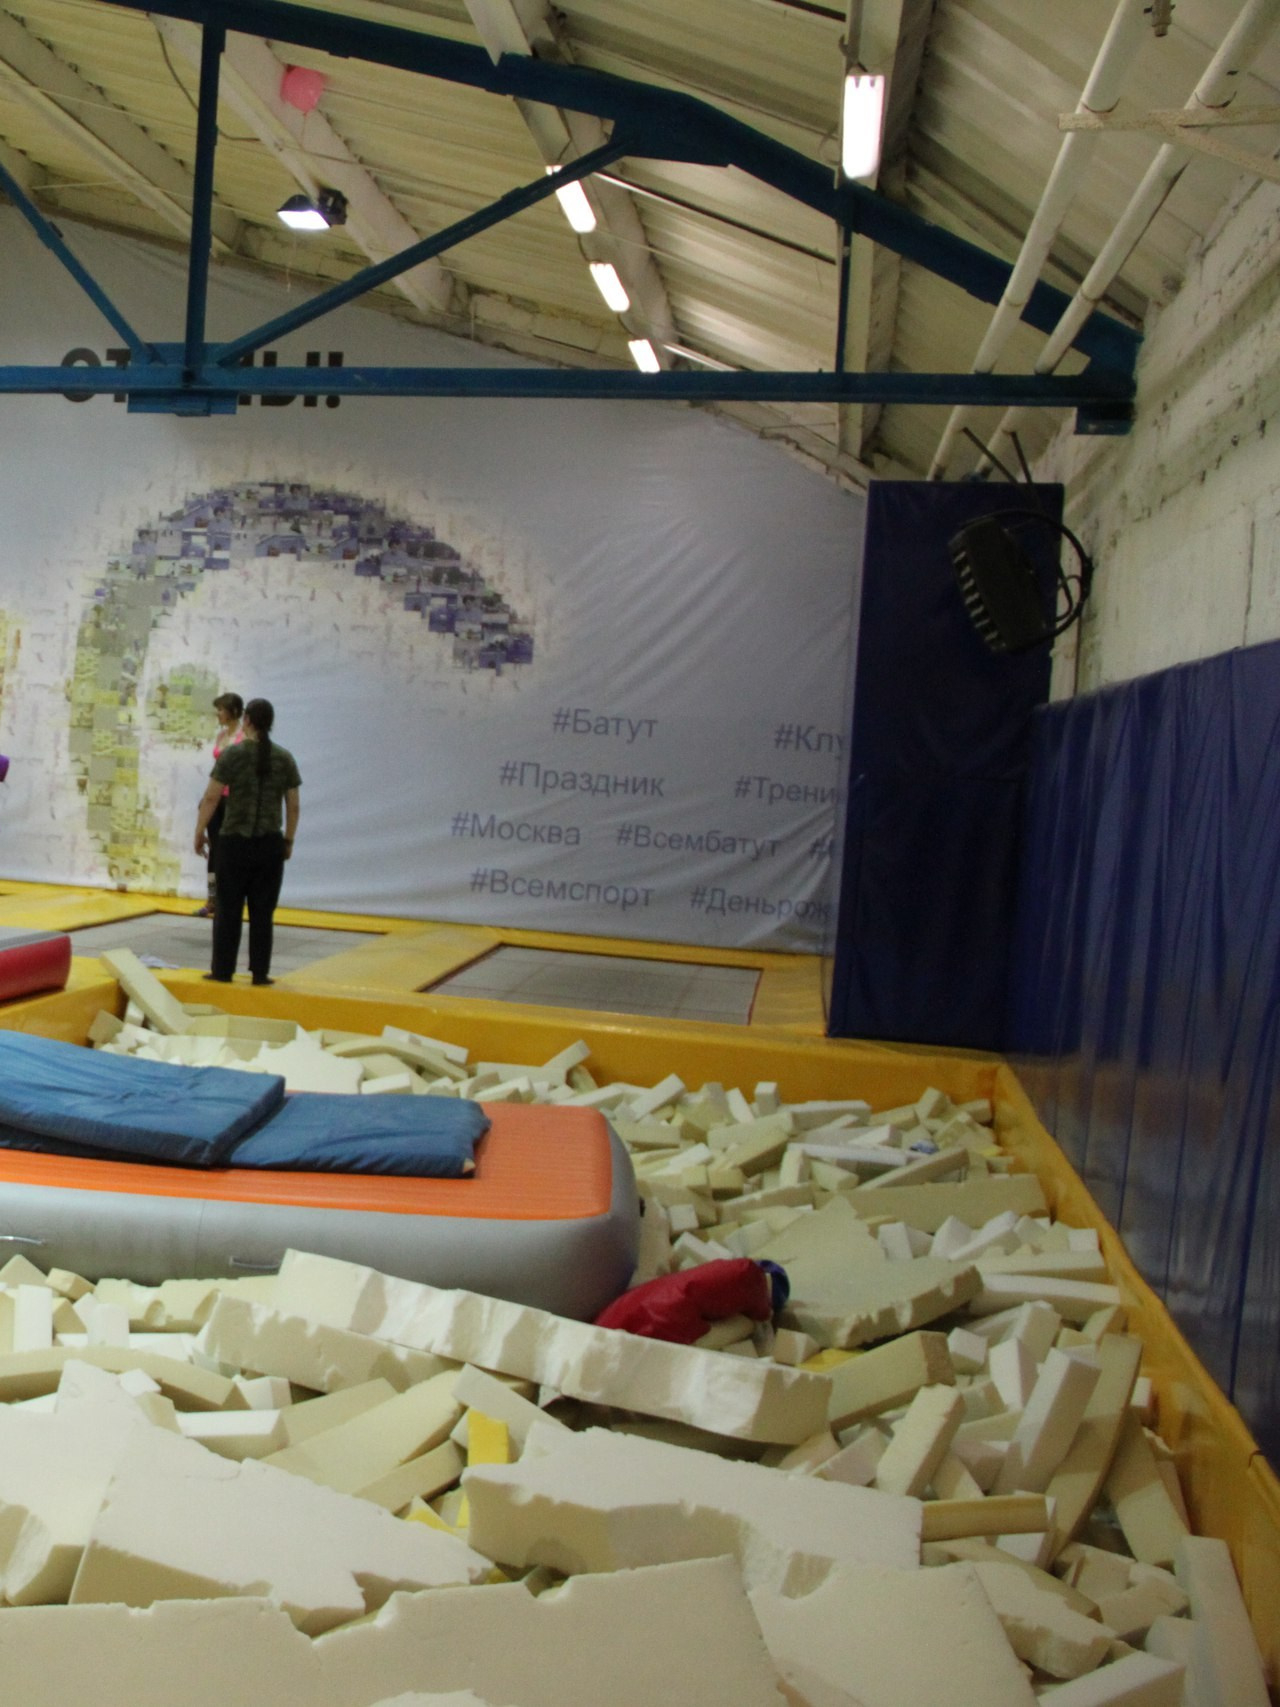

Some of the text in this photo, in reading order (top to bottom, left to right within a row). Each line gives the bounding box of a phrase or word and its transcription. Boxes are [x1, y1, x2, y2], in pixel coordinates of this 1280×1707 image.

[552, 707, 658, 744] #Батут
[499, 760, 664, 797] #Праздник
[451, 812, 581, 847] #Москва
[617, 823, 782, 861] #Всембатут
[470, 868, 655, 911] #Всемспорт
